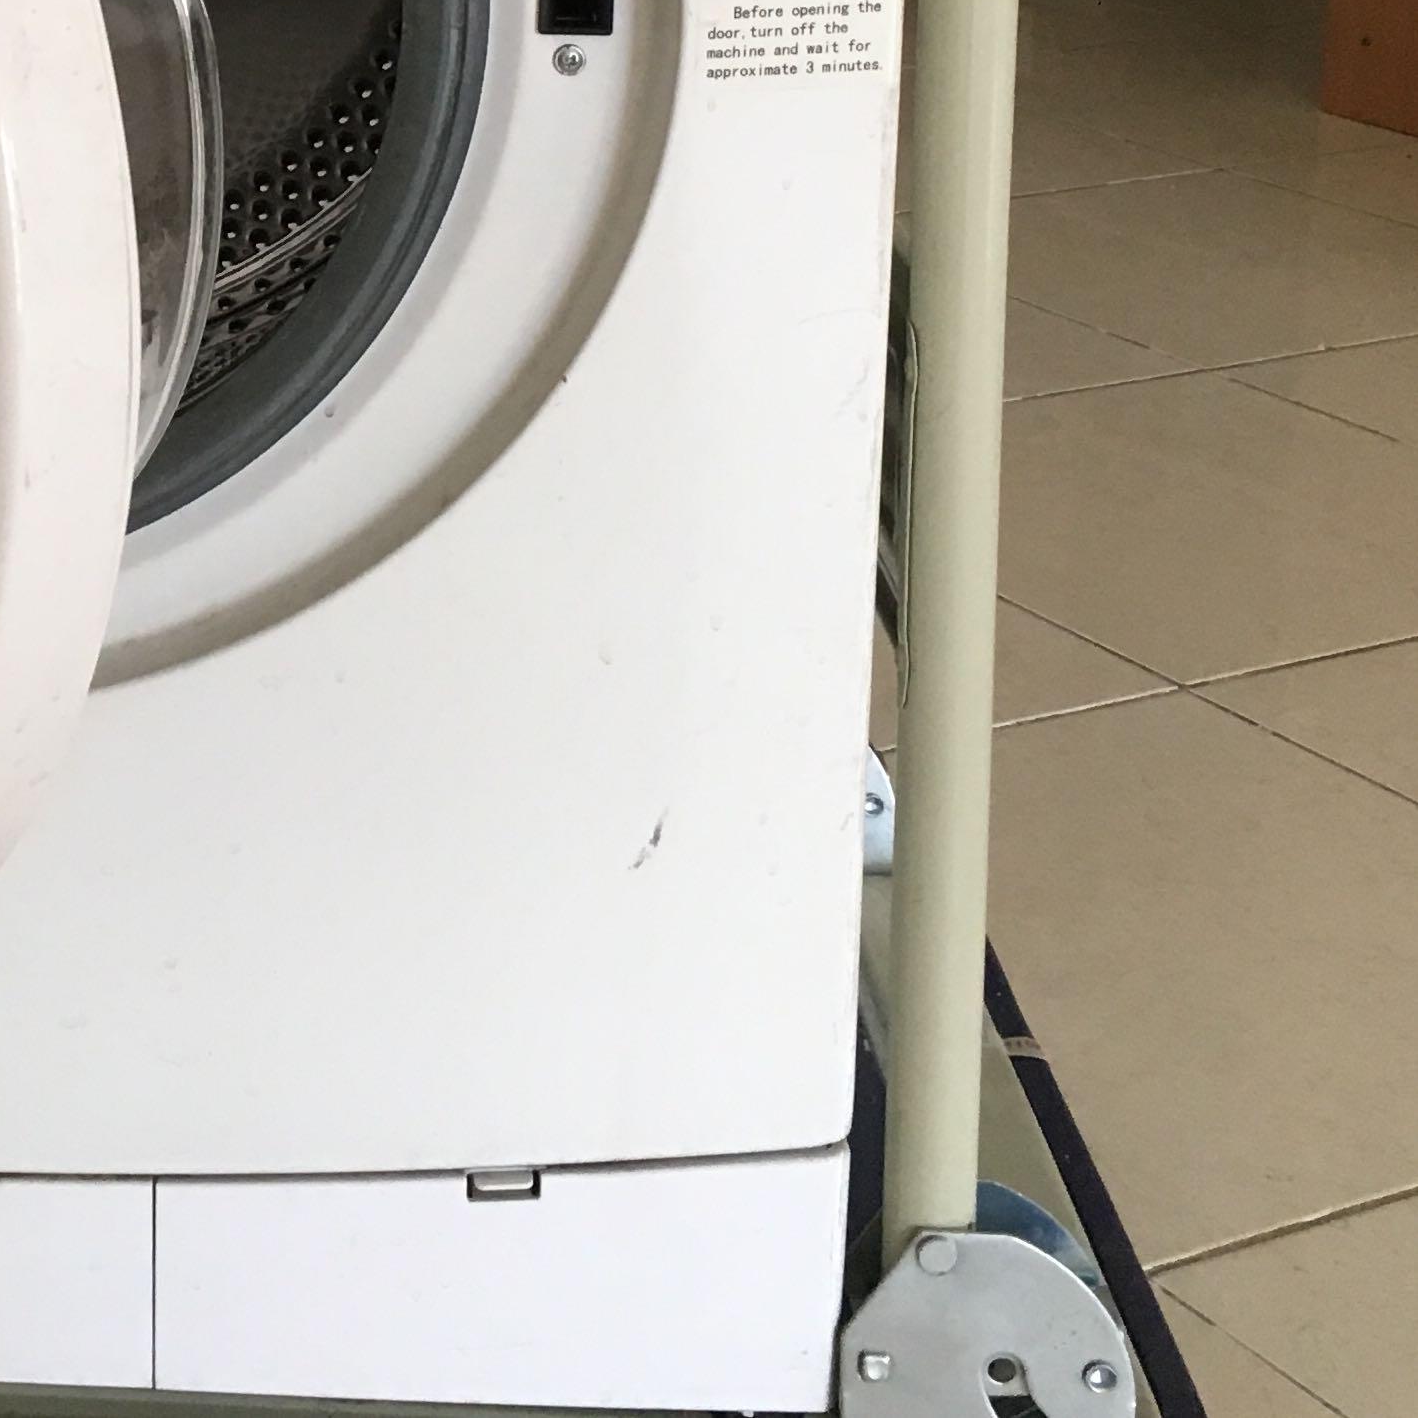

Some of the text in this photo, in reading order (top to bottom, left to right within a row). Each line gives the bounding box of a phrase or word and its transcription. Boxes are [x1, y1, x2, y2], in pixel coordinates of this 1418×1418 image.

[733, 0, 882, 19] Before opening the
[791, 23, 816, 36] off
[824, 21, 849, 34] the
[706, 39, 871, 59] machine and wait for
[706, 63, 797, 79] approximate
[805, 61, 815, 74] 3
